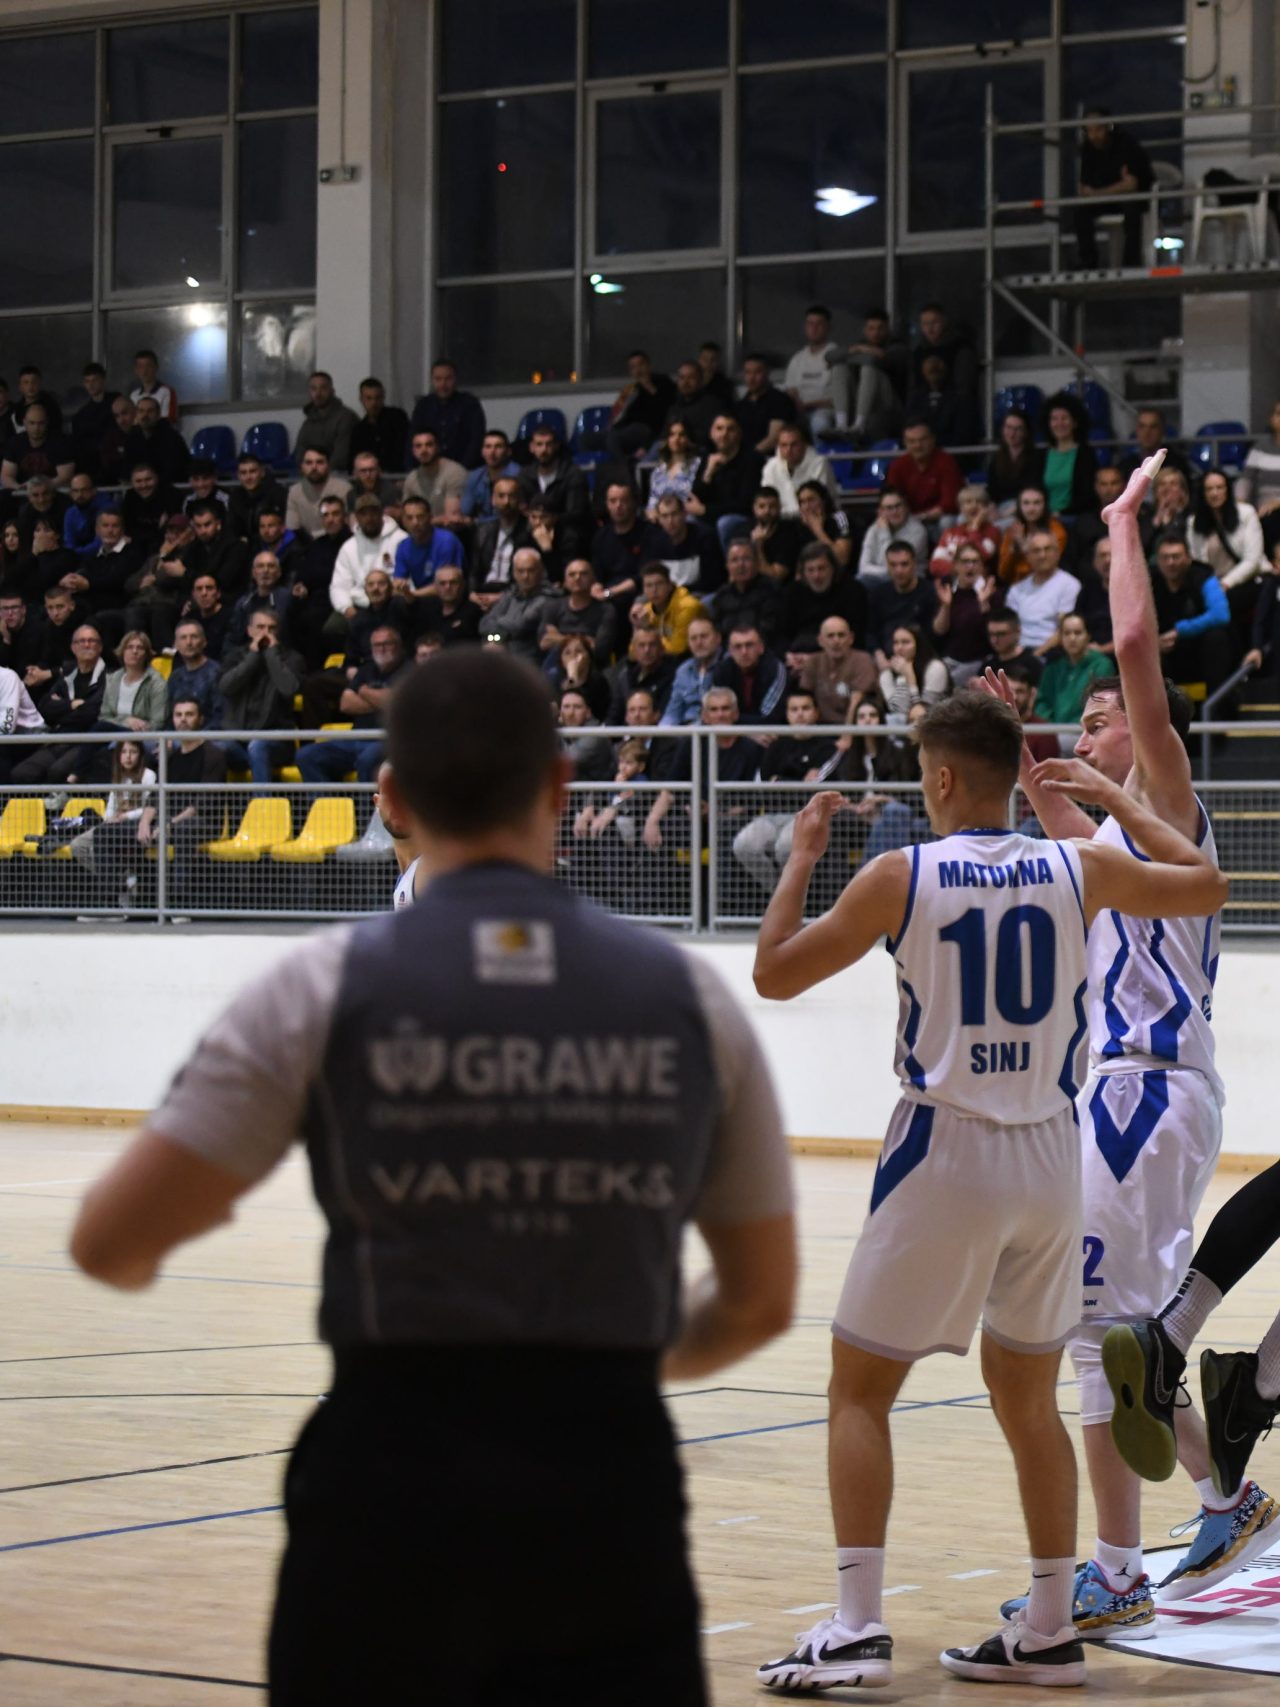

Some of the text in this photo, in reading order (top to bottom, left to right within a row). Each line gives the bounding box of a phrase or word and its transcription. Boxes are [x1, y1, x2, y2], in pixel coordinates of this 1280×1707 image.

[939, 905, 1056, 1026] 10
[450, 1035, 681, 1098] GRAWE
[971, 1041, 1031, 1074] SINJ
